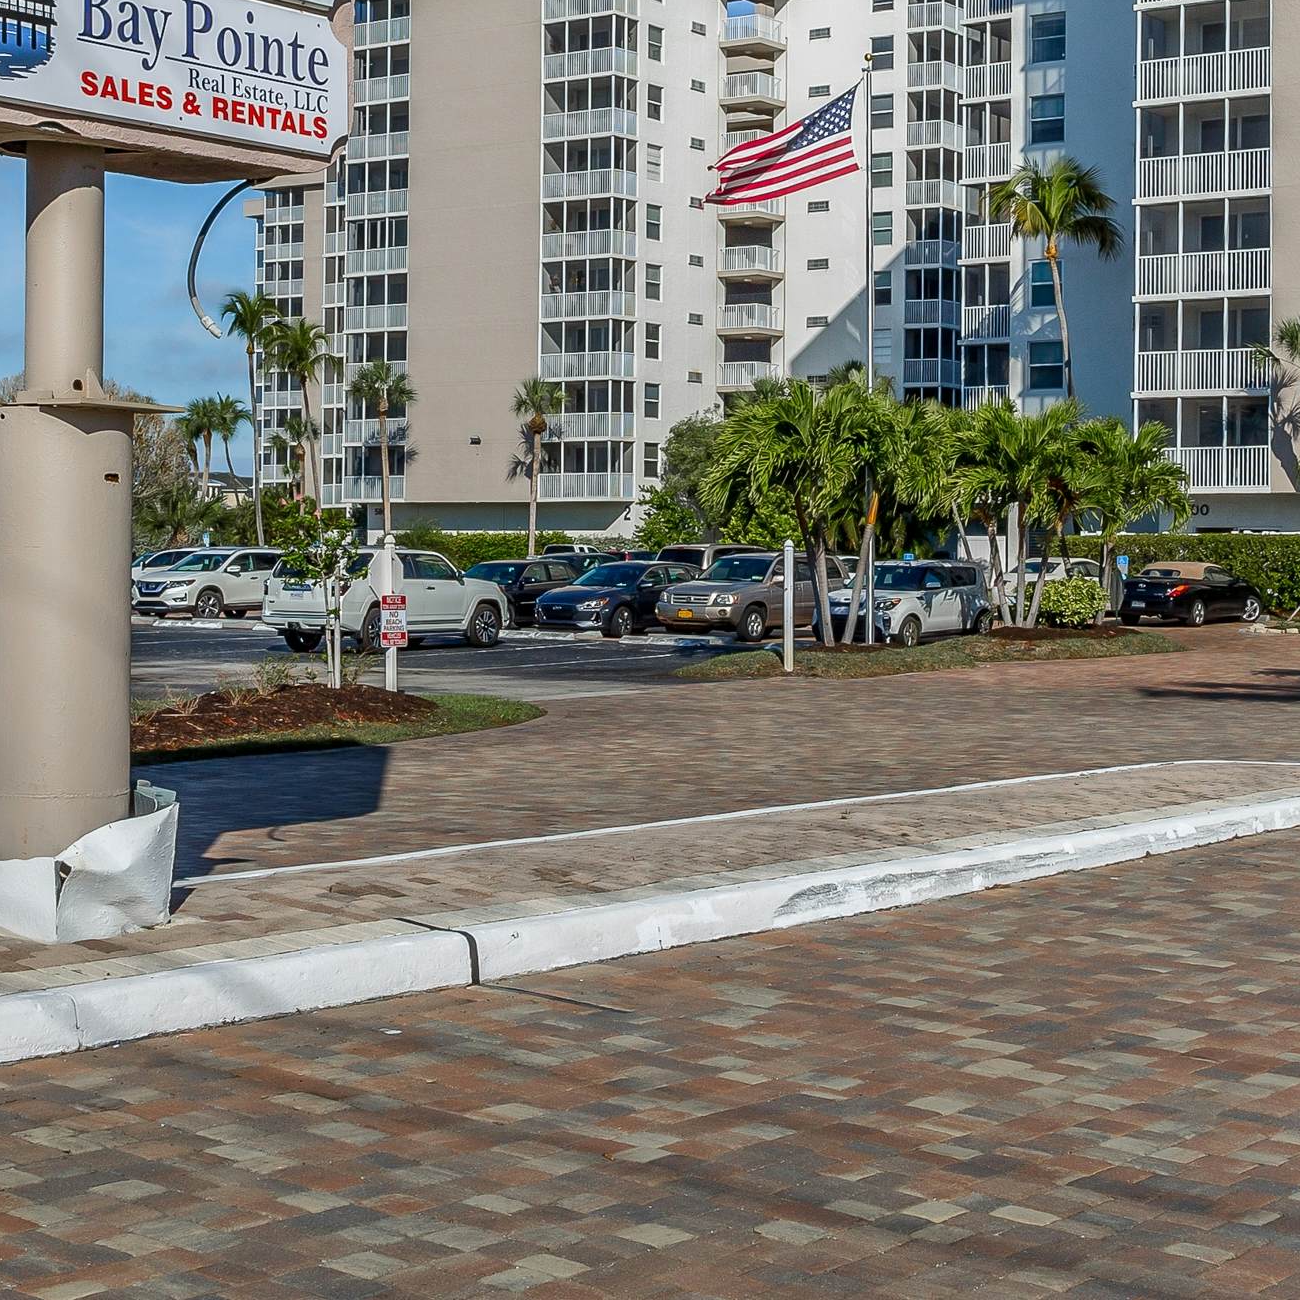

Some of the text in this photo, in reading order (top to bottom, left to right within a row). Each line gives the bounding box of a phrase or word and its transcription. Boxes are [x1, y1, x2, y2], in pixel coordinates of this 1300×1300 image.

[81, 71, 329, 140] SALES & RENTALS
[187, 68, 329, 115] Real Estate, LLC
[623, 505, 631, 521] 2
[385, 618, 403, 626] BEACH
